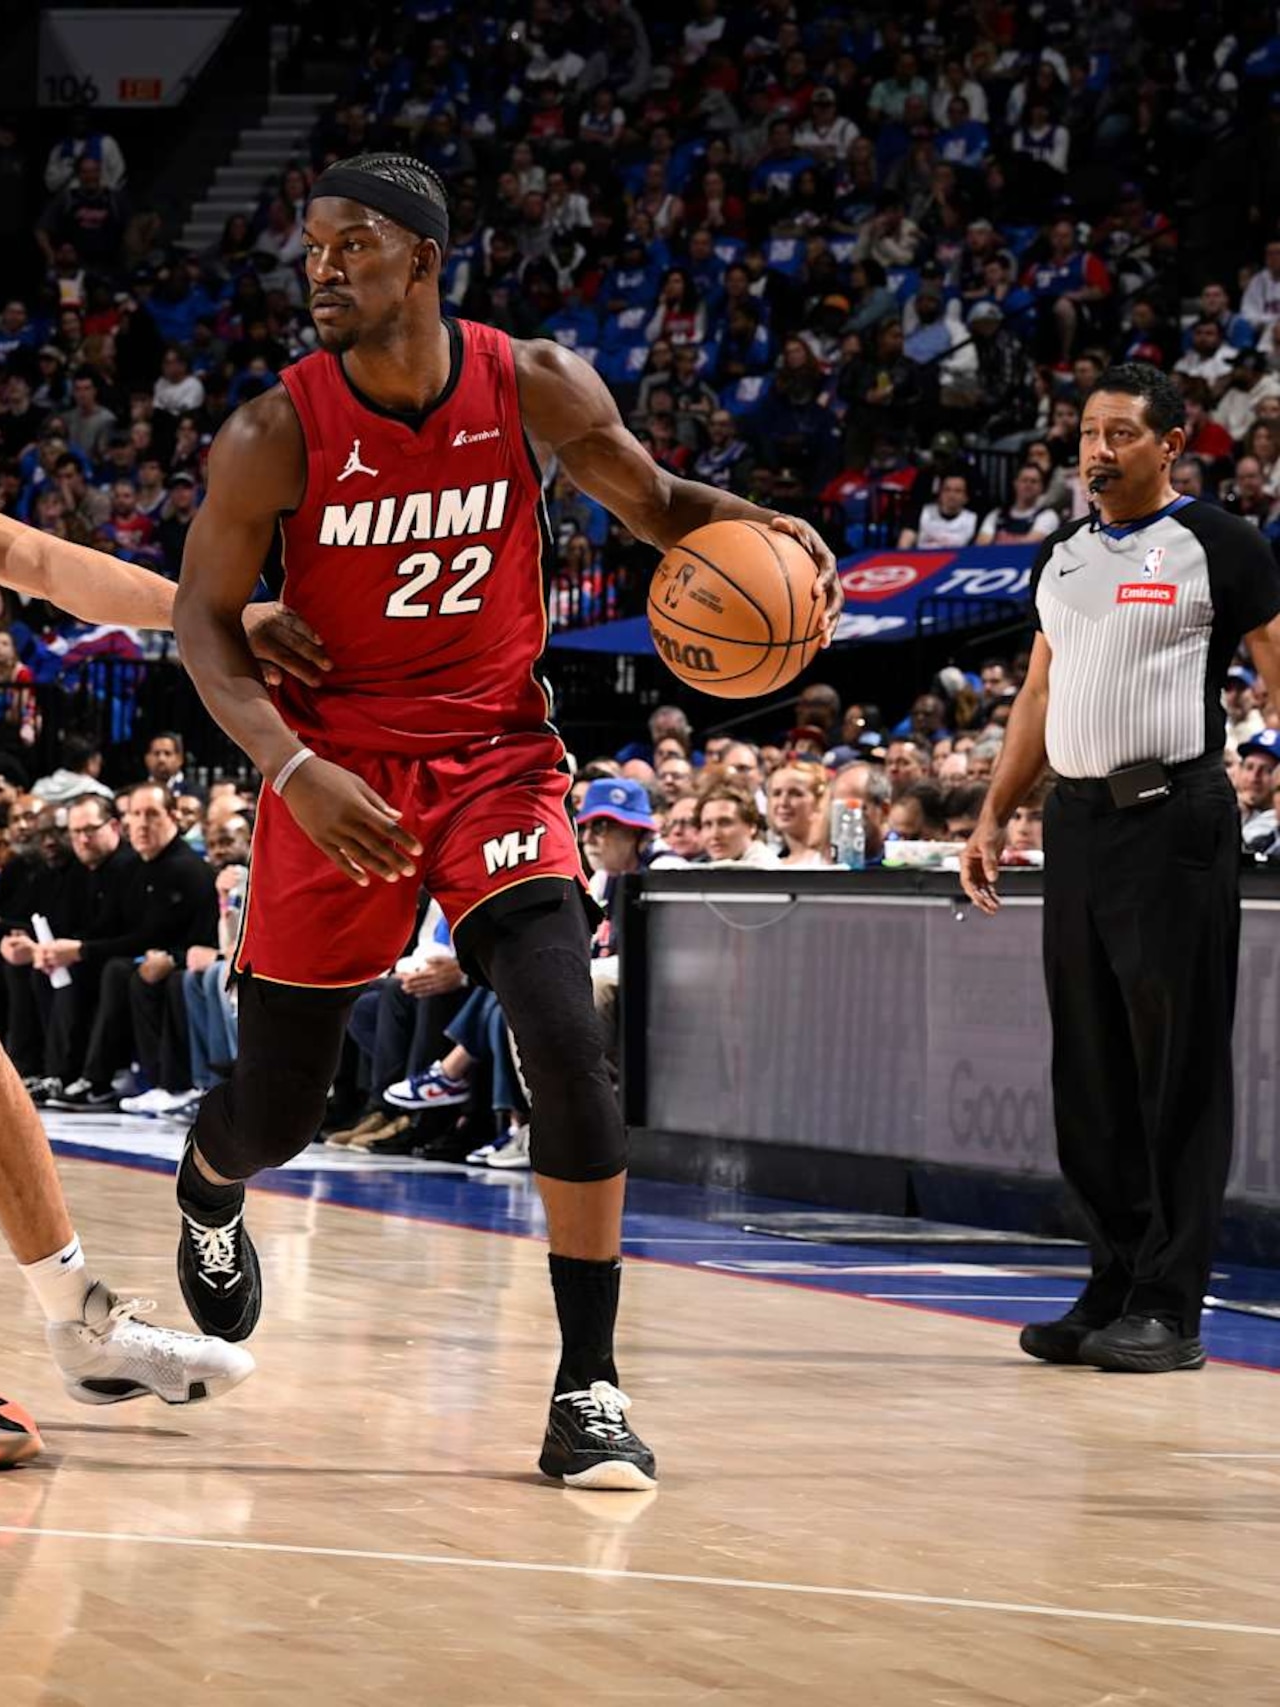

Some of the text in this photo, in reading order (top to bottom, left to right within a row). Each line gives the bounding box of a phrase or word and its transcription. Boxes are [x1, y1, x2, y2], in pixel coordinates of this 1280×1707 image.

[44, 75, 98, 103] 106
[462, 428, 500, 444] Carnival
[318, 480, 509, 546] MIAMI
[384, 545, 493, 618] 22
[1120, 587, 1171, 600] Emirates
